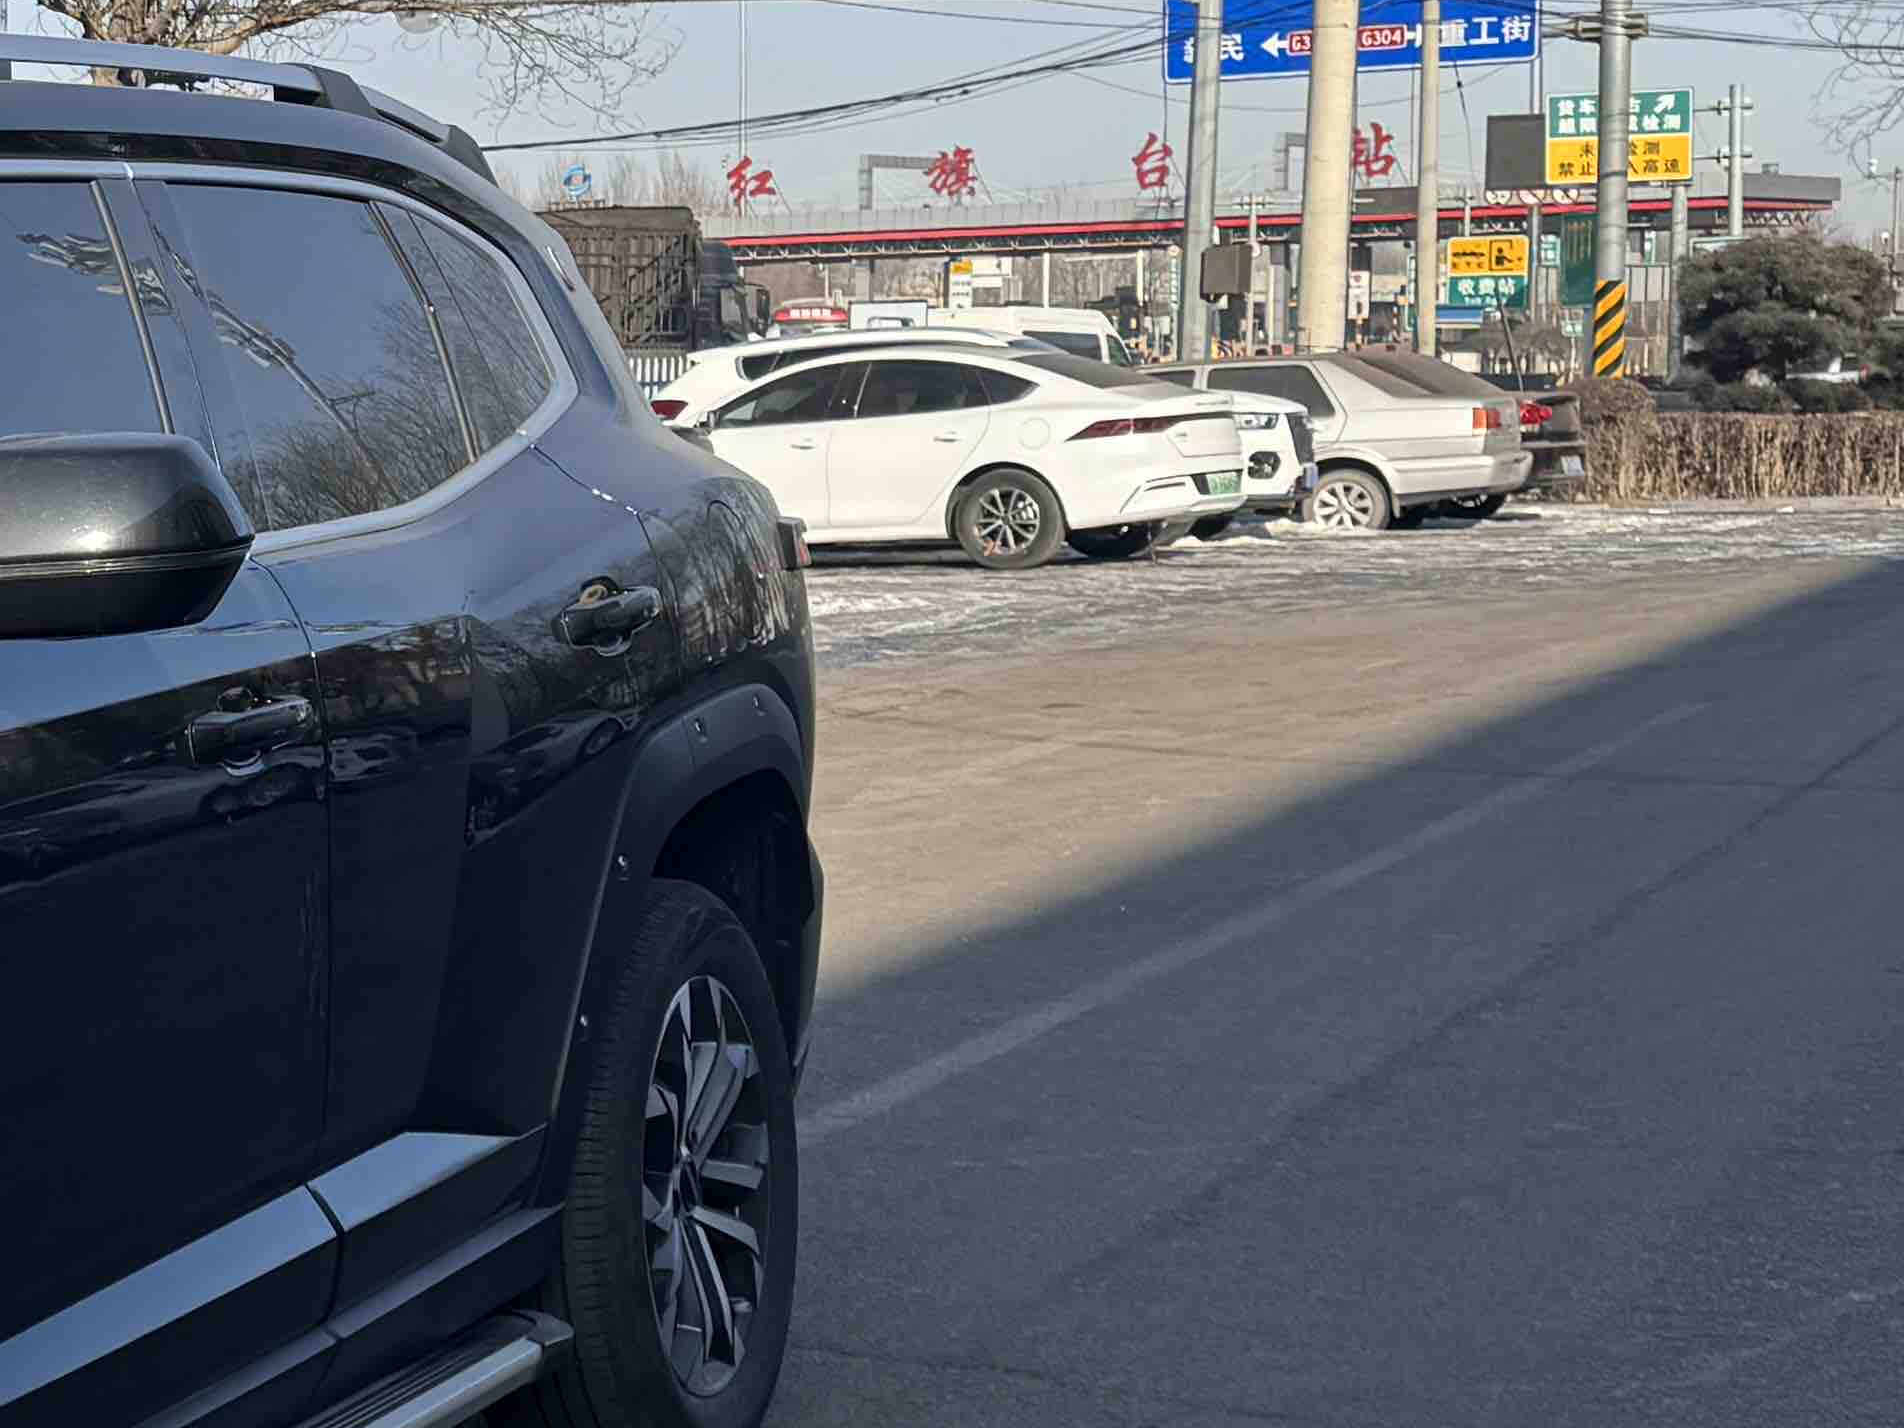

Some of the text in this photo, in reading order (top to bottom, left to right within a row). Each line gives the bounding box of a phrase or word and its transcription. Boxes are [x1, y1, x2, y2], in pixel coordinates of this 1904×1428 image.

[1361, 29, 1402, 46] G304
[1439, 16, 1531, 47] 重工街
